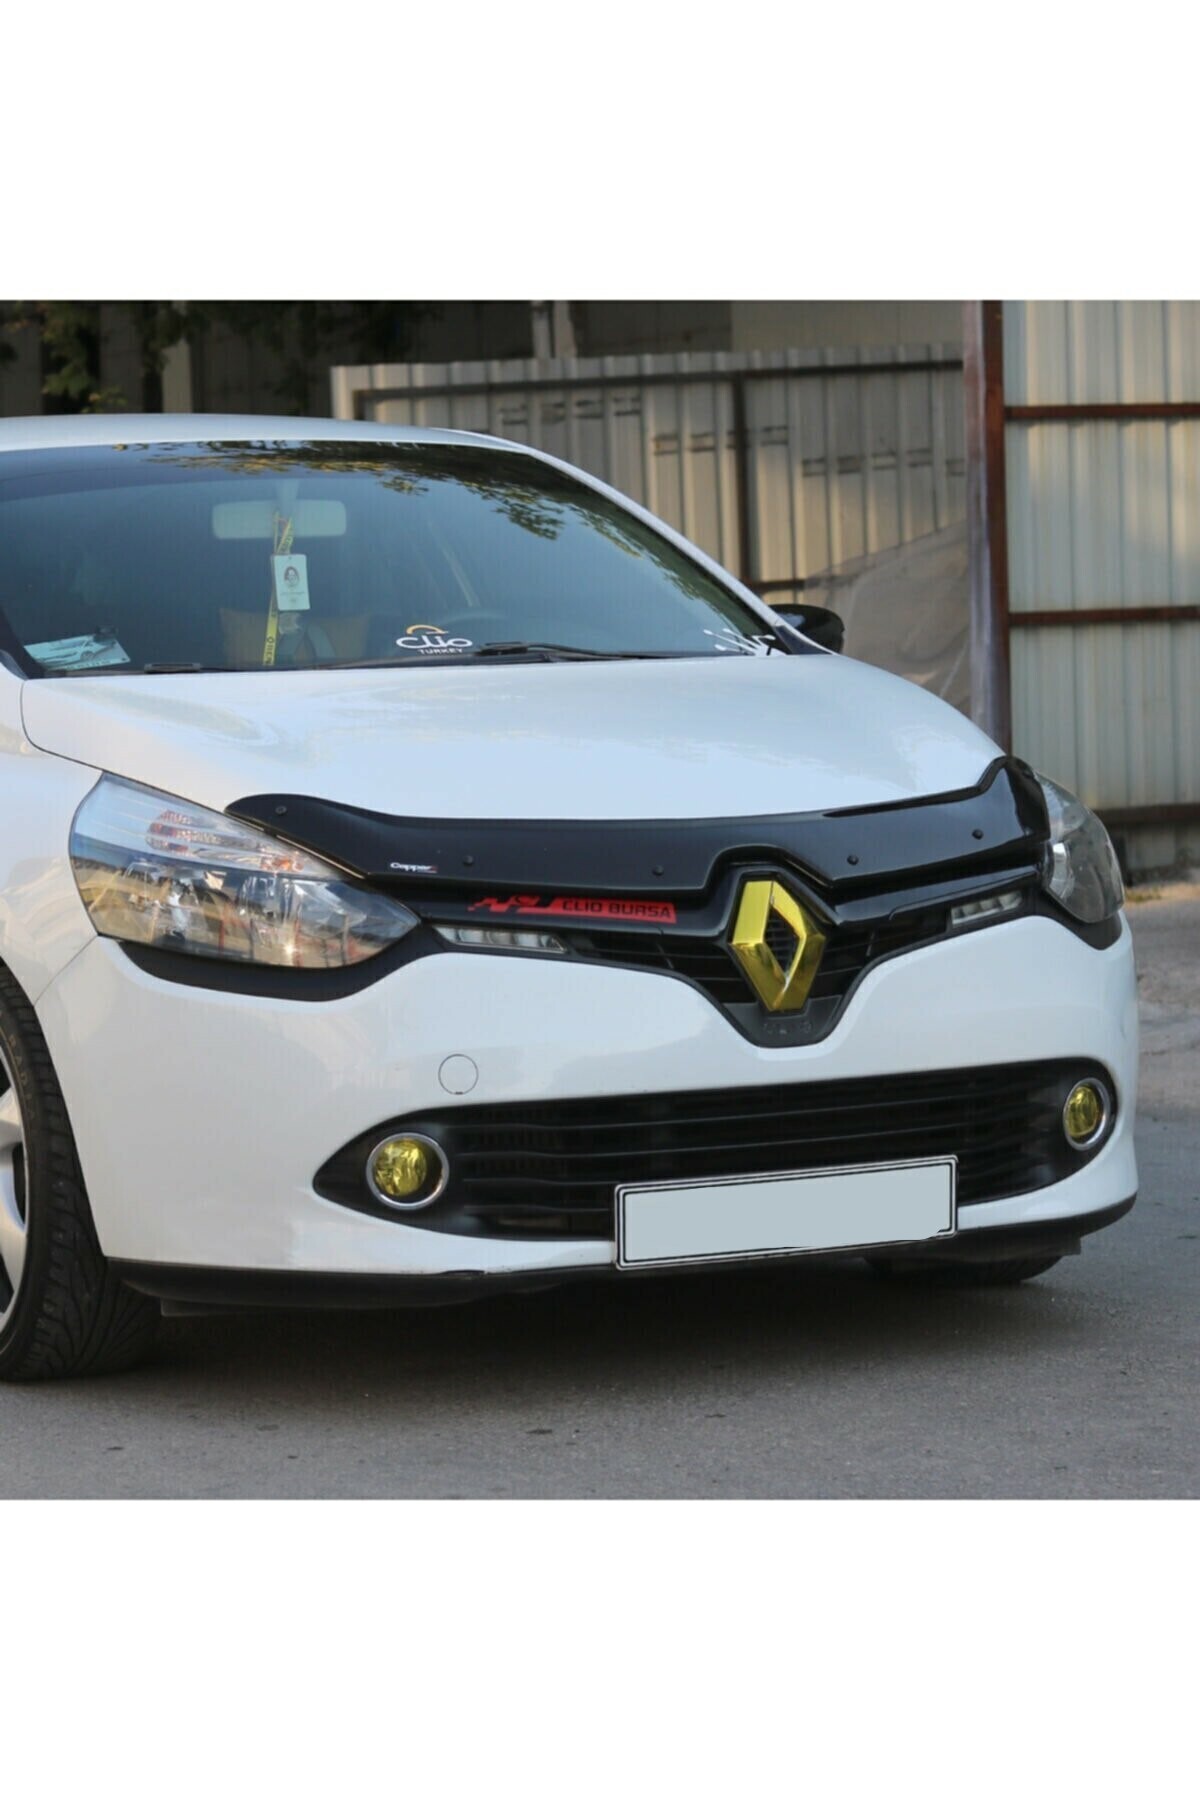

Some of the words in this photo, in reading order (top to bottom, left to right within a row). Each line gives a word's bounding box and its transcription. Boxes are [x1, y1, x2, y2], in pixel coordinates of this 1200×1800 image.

[417, 647, 463, 655] TURKEY
[562, 899, 603, 913] CLIO
[608, 902, 672, 919] BURSA
